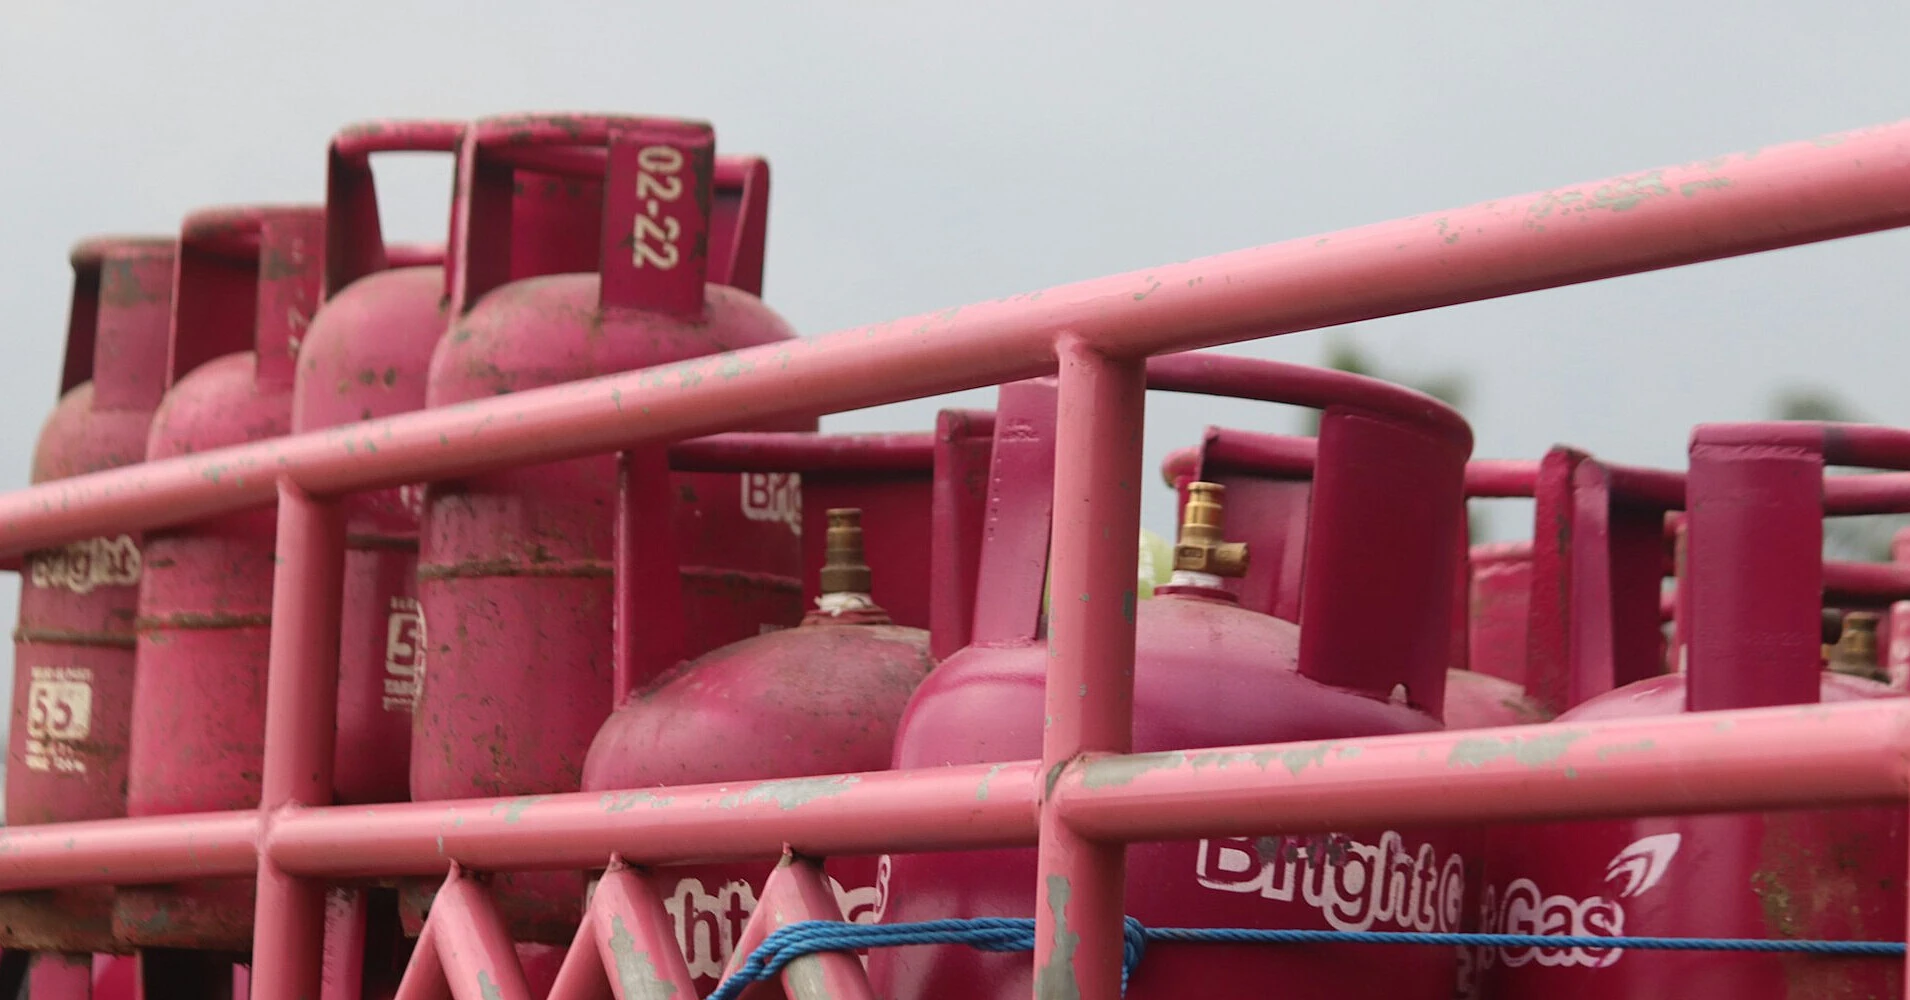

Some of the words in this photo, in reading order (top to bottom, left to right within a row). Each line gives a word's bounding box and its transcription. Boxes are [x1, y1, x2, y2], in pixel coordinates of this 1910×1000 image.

[632, 145, 684, 270] 02-22
[663, 878, 758, 980] ht
[1500, 878, 1625, 968] Gas
